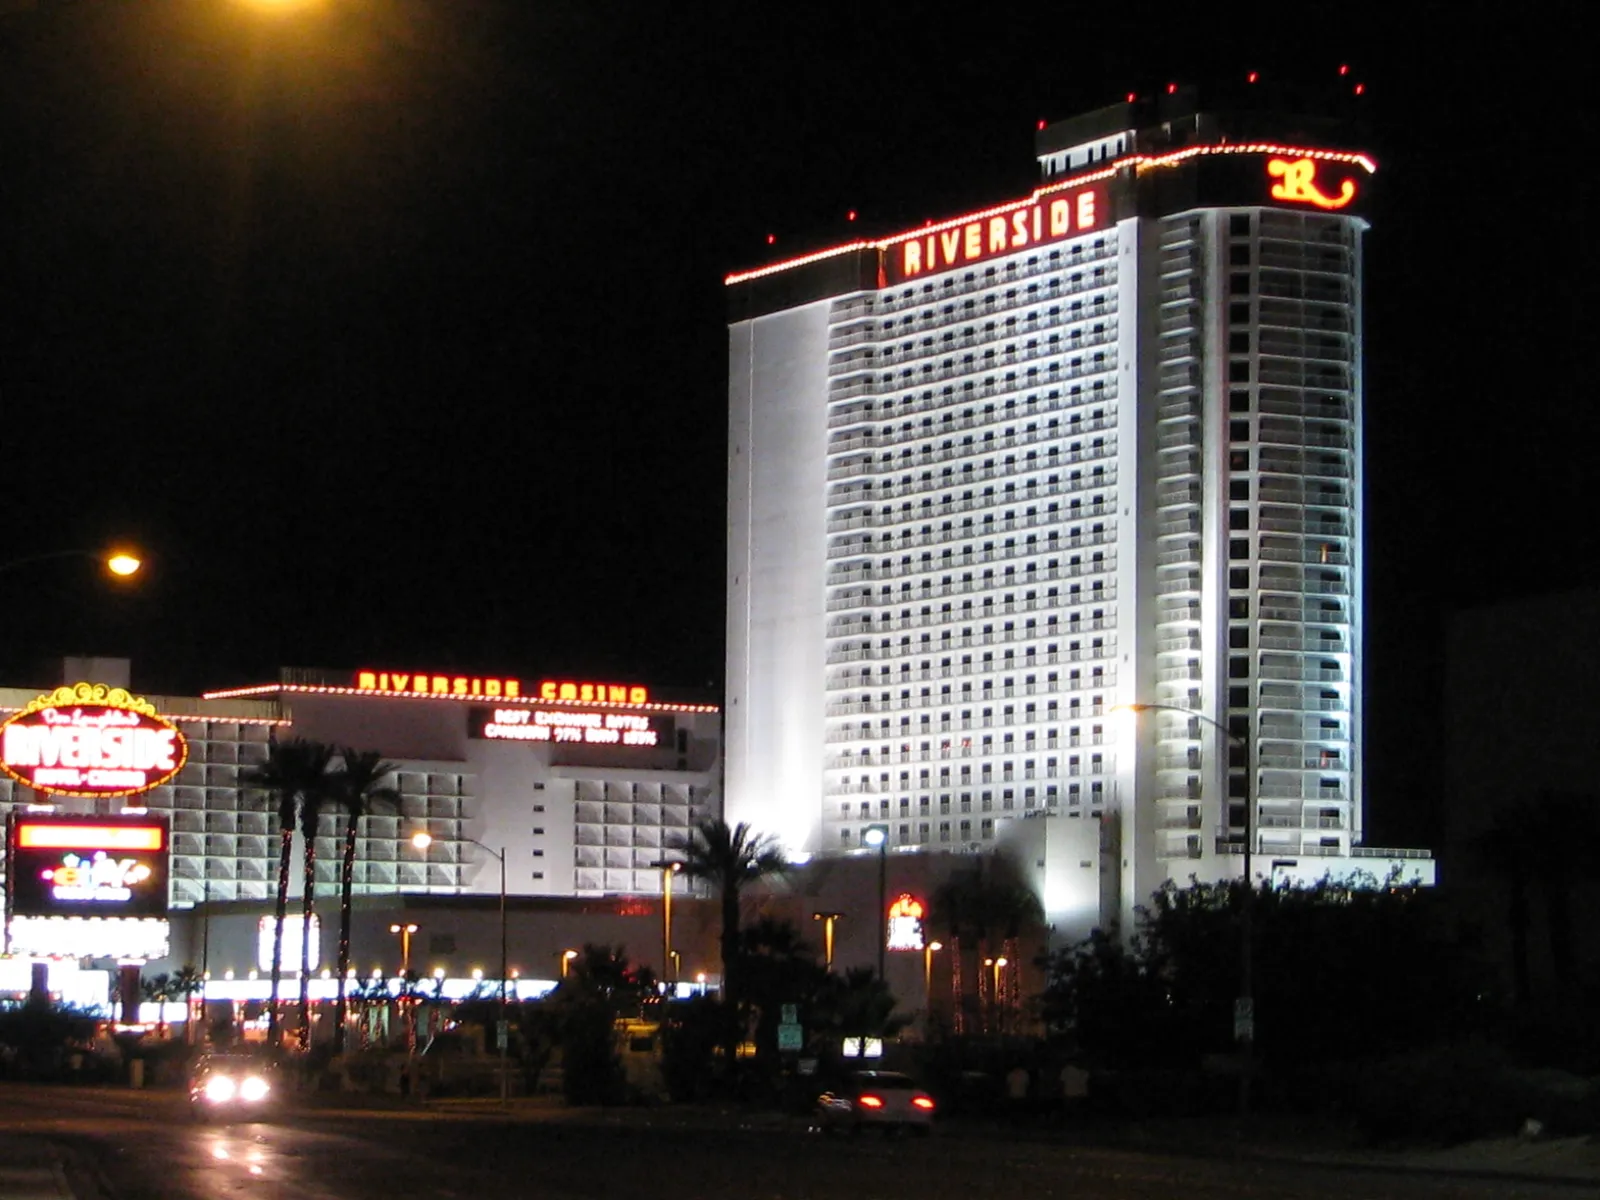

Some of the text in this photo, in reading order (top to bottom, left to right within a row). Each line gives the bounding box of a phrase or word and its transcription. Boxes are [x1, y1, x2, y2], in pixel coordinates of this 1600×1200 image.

[903, 191, 1096, 276] RIVERSIDE
[358, 672, 647, 704] RIVERSIDE CASINO
[494, 708, 531, 725] BEST
[4, 725, 176, 770] RIVERSIDE
